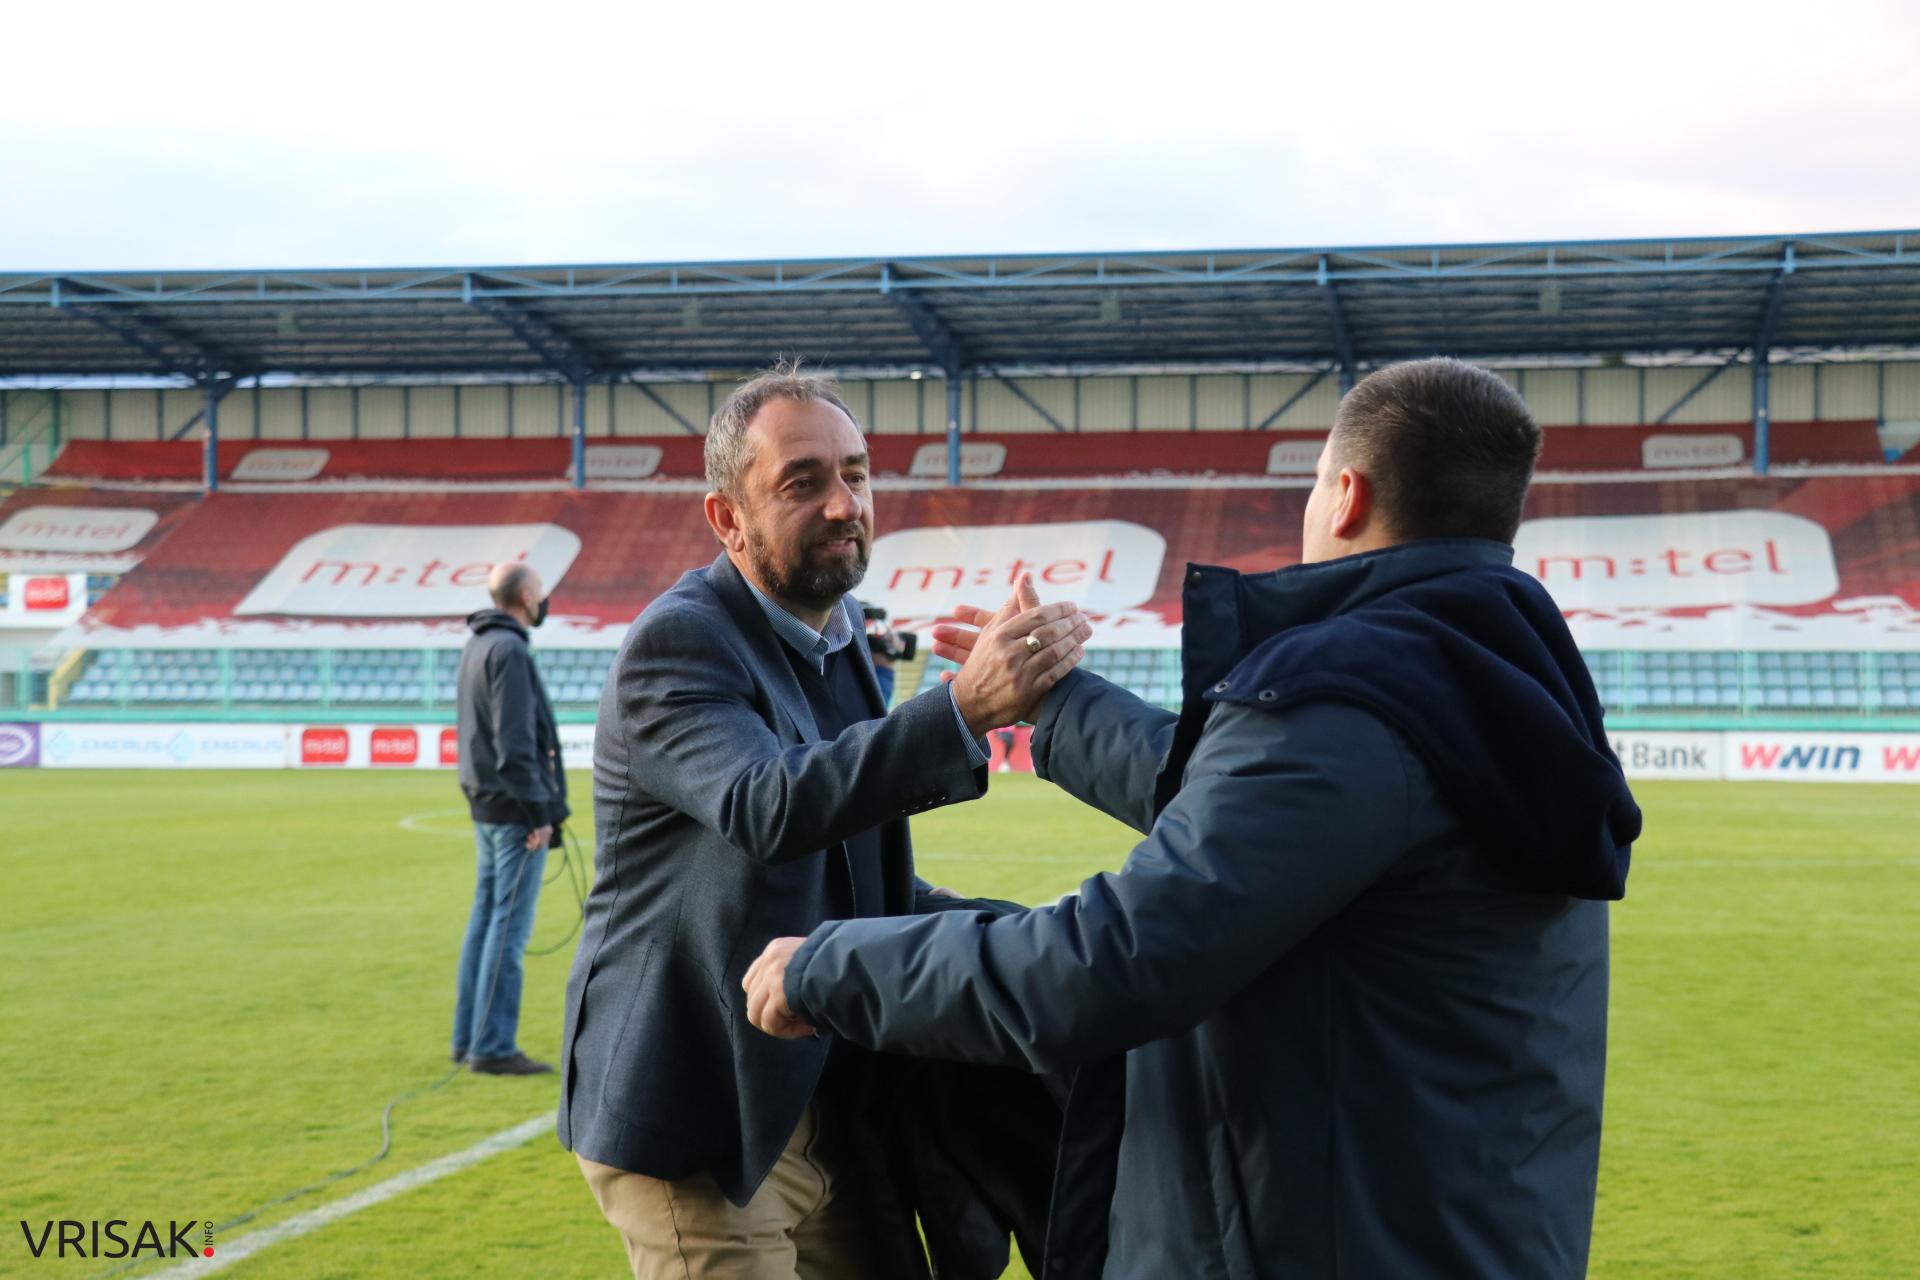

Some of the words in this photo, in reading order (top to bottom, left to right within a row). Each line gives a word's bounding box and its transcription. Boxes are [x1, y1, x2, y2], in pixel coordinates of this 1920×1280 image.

[15, 522, 131, 539] m:tel
[888, 549, 1115, 591] m:tel
[1537, 538, 1790, 581] m:tel
[1632, 740, 1708, 769] Bank
